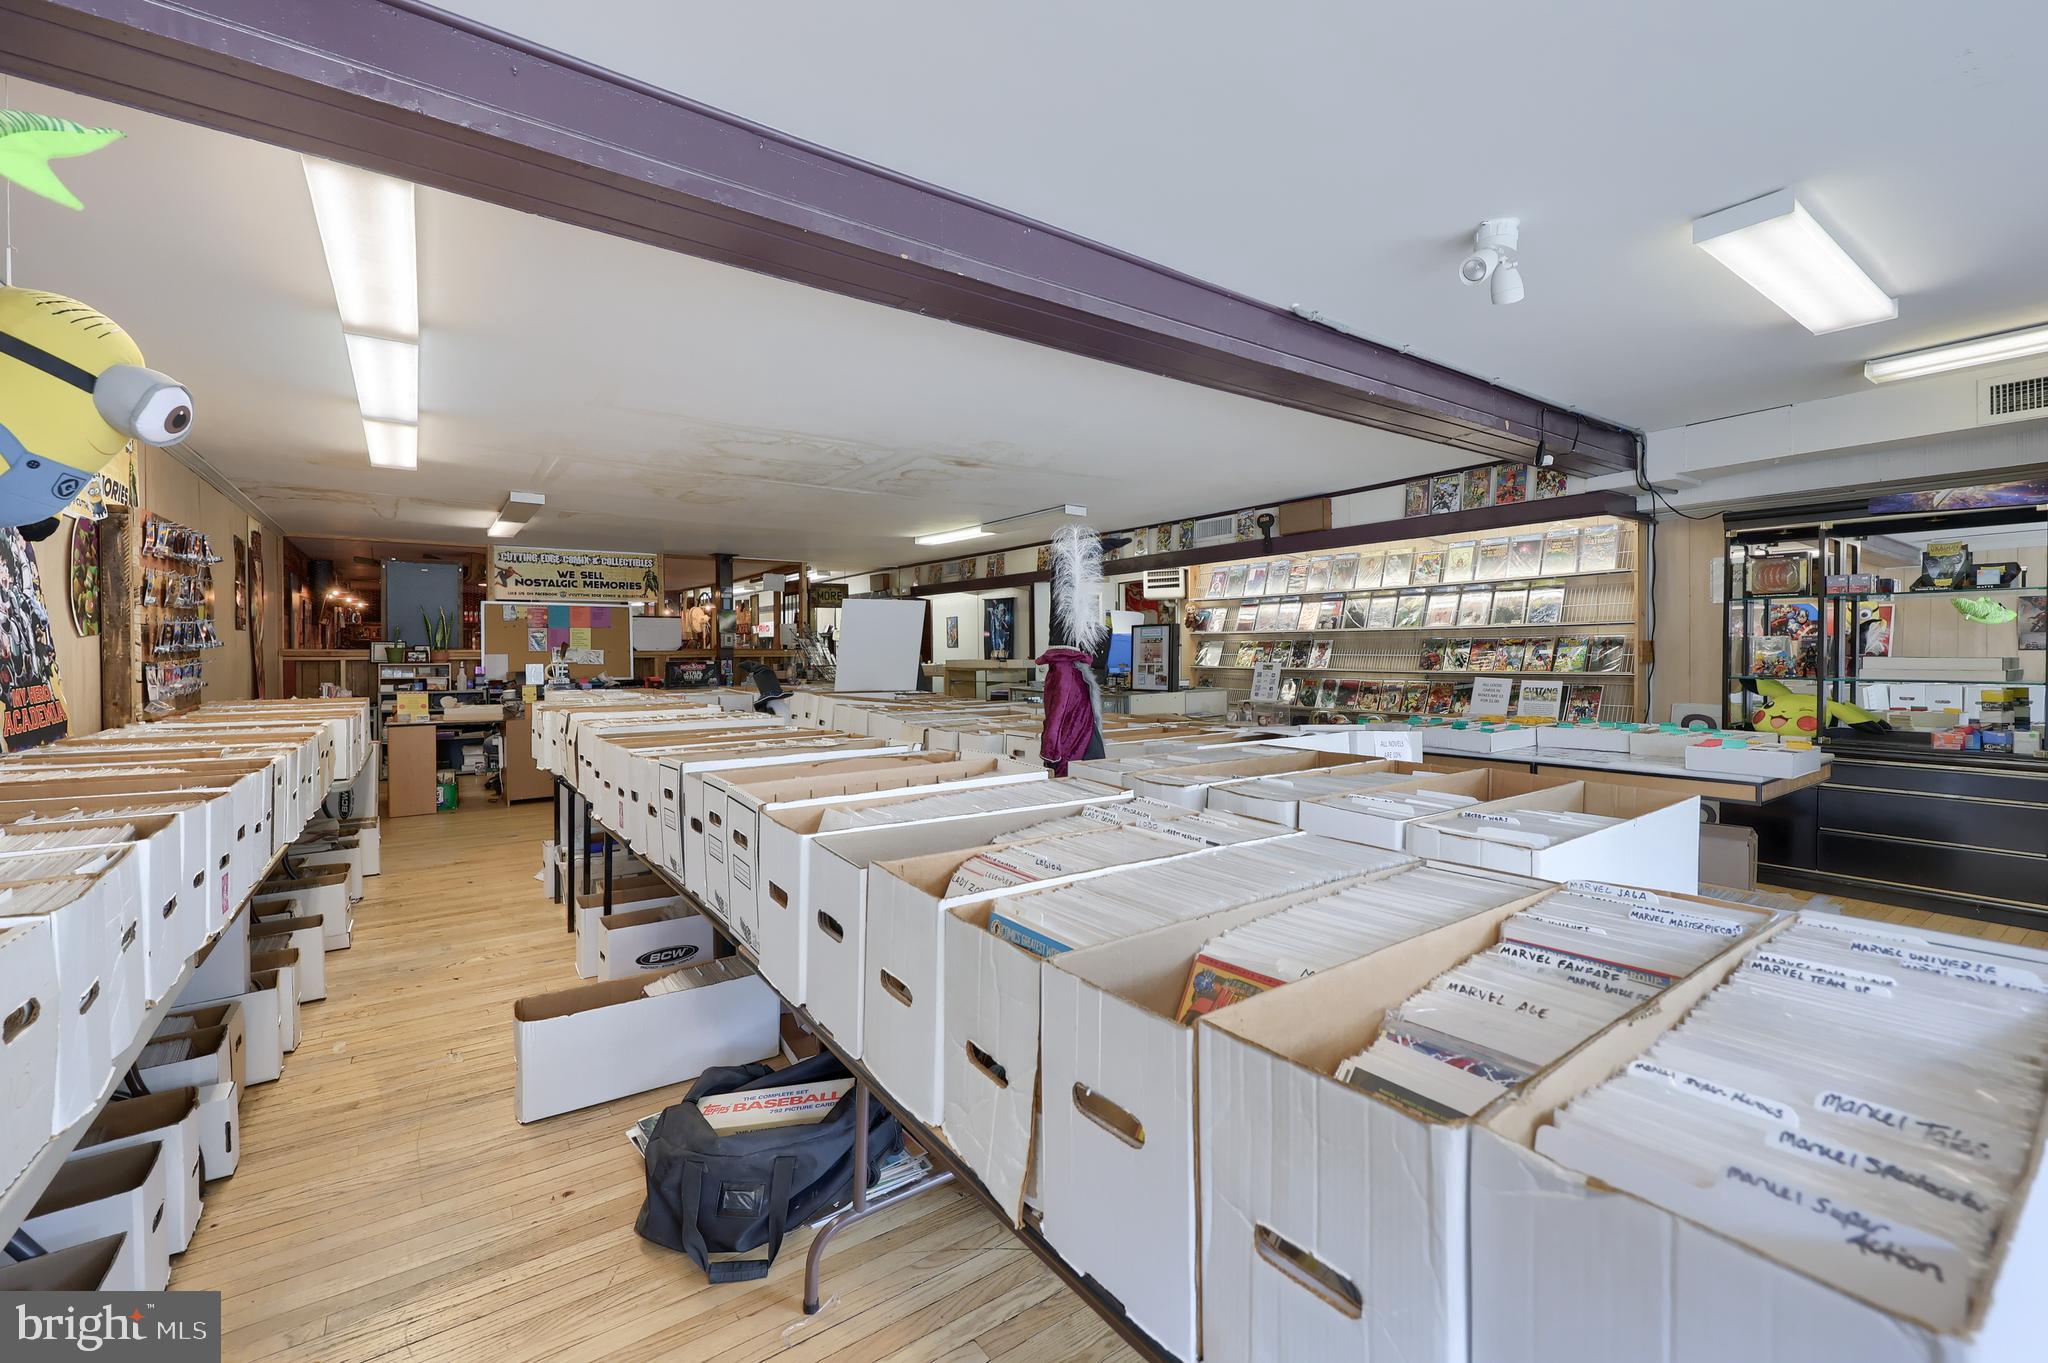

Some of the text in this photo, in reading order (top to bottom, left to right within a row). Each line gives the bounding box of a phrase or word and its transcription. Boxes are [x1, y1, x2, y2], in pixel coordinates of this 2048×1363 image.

[500, 551, 538, 563] CUTTING
[540, 553, 560, 564] EDGE
[601, 556, 654, 568] COLLECTIBLES
[556, 569, 605, 580] WE SELL
[514, 578, 642, 590] NOSTALGIC MEMORIES
[816, 591, 843, 601] MORE
[11, 683, 52, 708] MY HERO
[1523, 686, 1559, 697] CUTTING
[3, 700, 68, 738] ACADEMIA
[1084, 811, 1100, 820] LADY
[1035, 858, 1062, 872] LEGION
[951, 873, 968, 889] LADY
[1569, 882, 1613, 895] MARVEL
[1630, 910, 1666, 925] MARVEL
[649, 947, 689, 963] BCW
[1849, 941, 1904, 959] MARVEL
[1500, 946, 1552, 966] MARVEL
[1557, 959, 1621, 982] FANFARE
[1751, 961, 1805, 981] MARVEL
[1810, 974, 1847, 991] TEAM
[1853, 984, 1872, 995] UP
[1447, 981, 1550, 1019] MARVEL AGE
[732, 1091, 841, 1113] BASEBALL
[757, 1090, 795, 1101] COMPLETE
[784, 1104, 815, 1113] PICTURE
